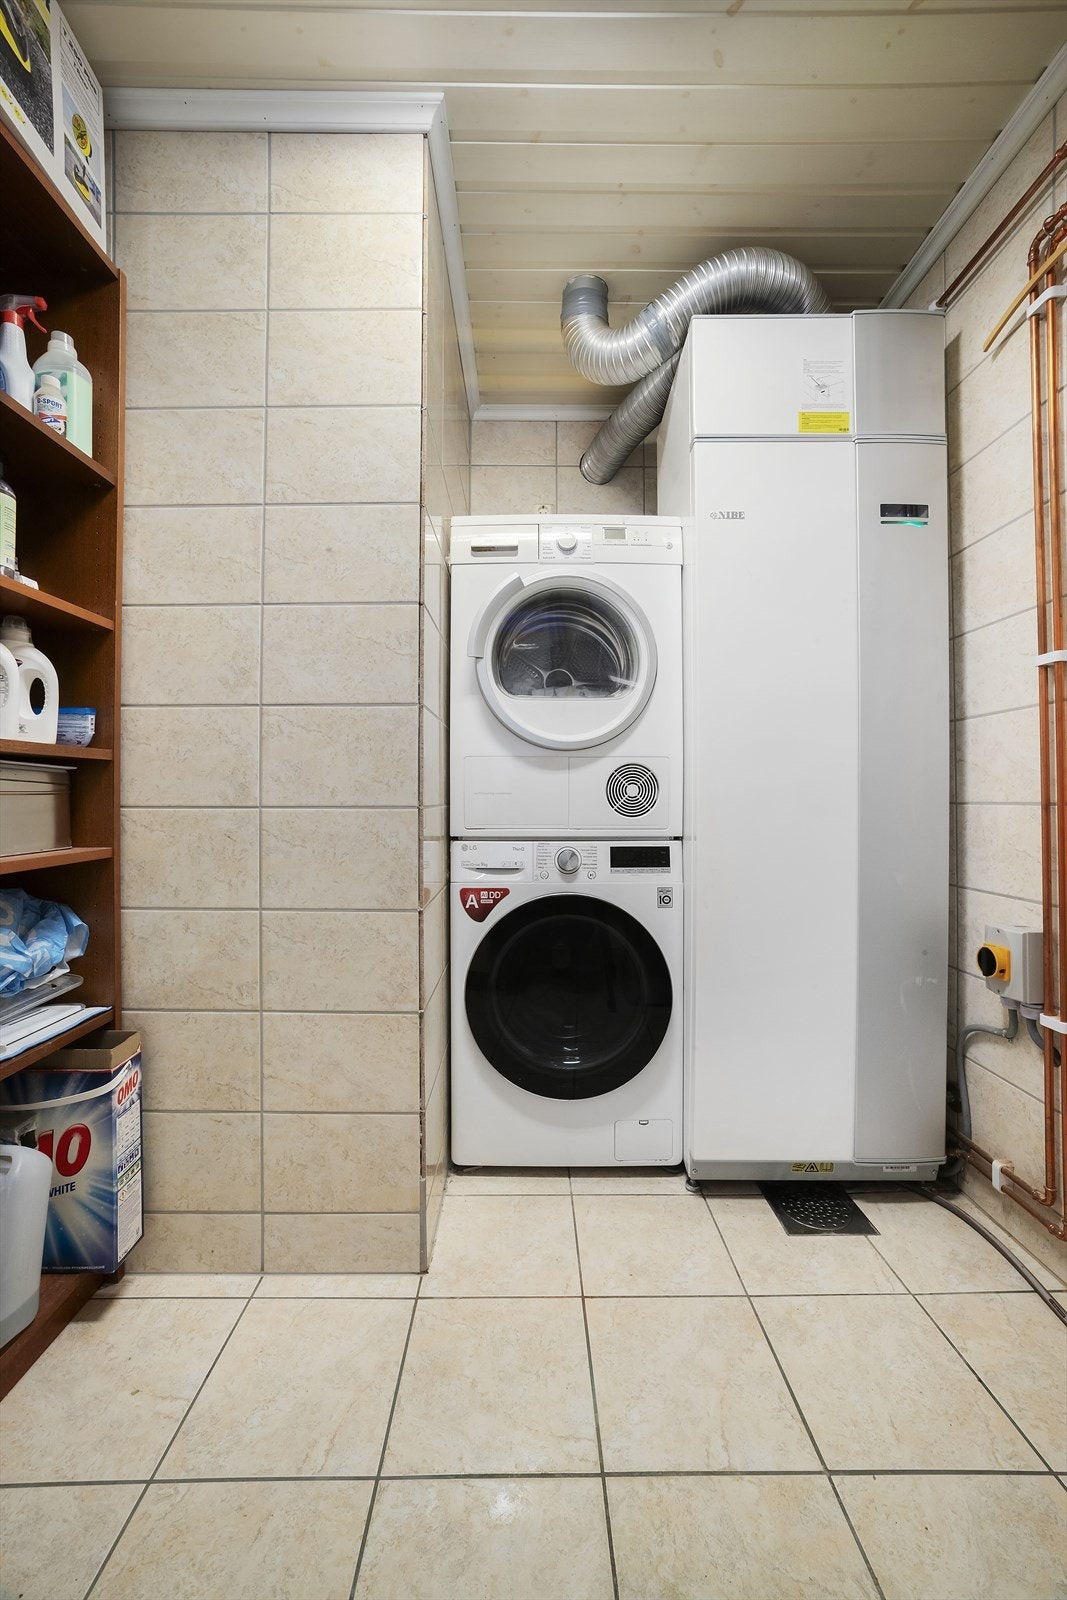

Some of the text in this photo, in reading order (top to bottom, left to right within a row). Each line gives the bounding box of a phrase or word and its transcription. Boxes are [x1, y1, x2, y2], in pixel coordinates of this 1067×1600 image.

[718, 511, 745, 519] NIBE
[465, 894, 479, 908] A
[117, 1070, 138, 1105] OMO
